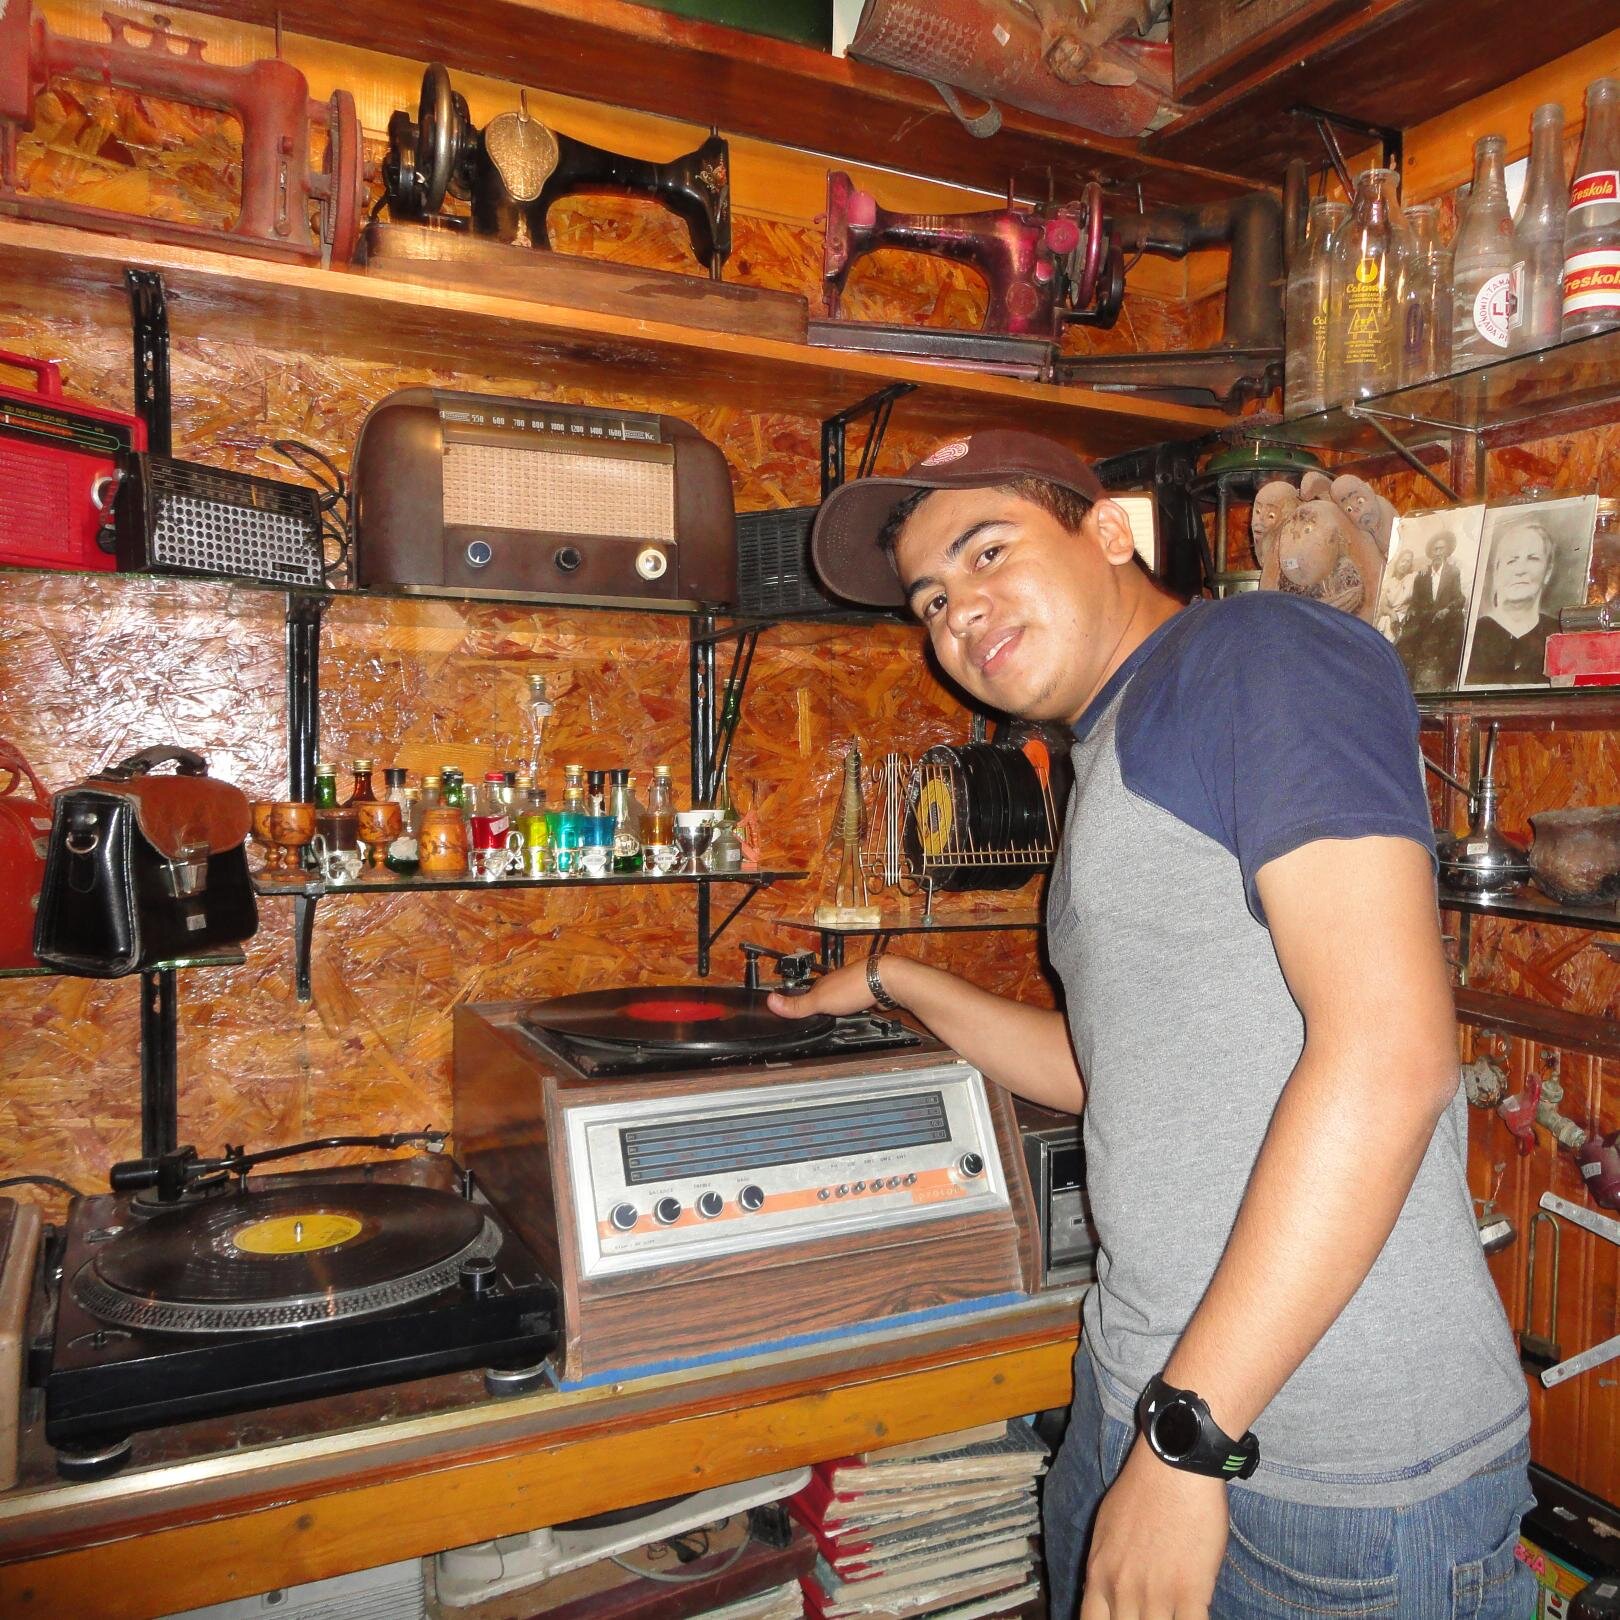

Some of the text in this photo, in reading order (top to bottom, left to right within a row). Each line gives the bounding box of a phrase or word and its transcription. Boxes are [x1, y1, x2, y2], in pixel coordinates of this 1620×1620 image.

[492, 416, 505, 425] 600
[512, 419, 525, 427] 700
[532, 421, 544, 429] 800
[550, 423, 564, 431] 1000
[571, 424, 584, 433] 1200
[590, 426, 602, 435] 1400
[608, 428, 621, 437] 1600
